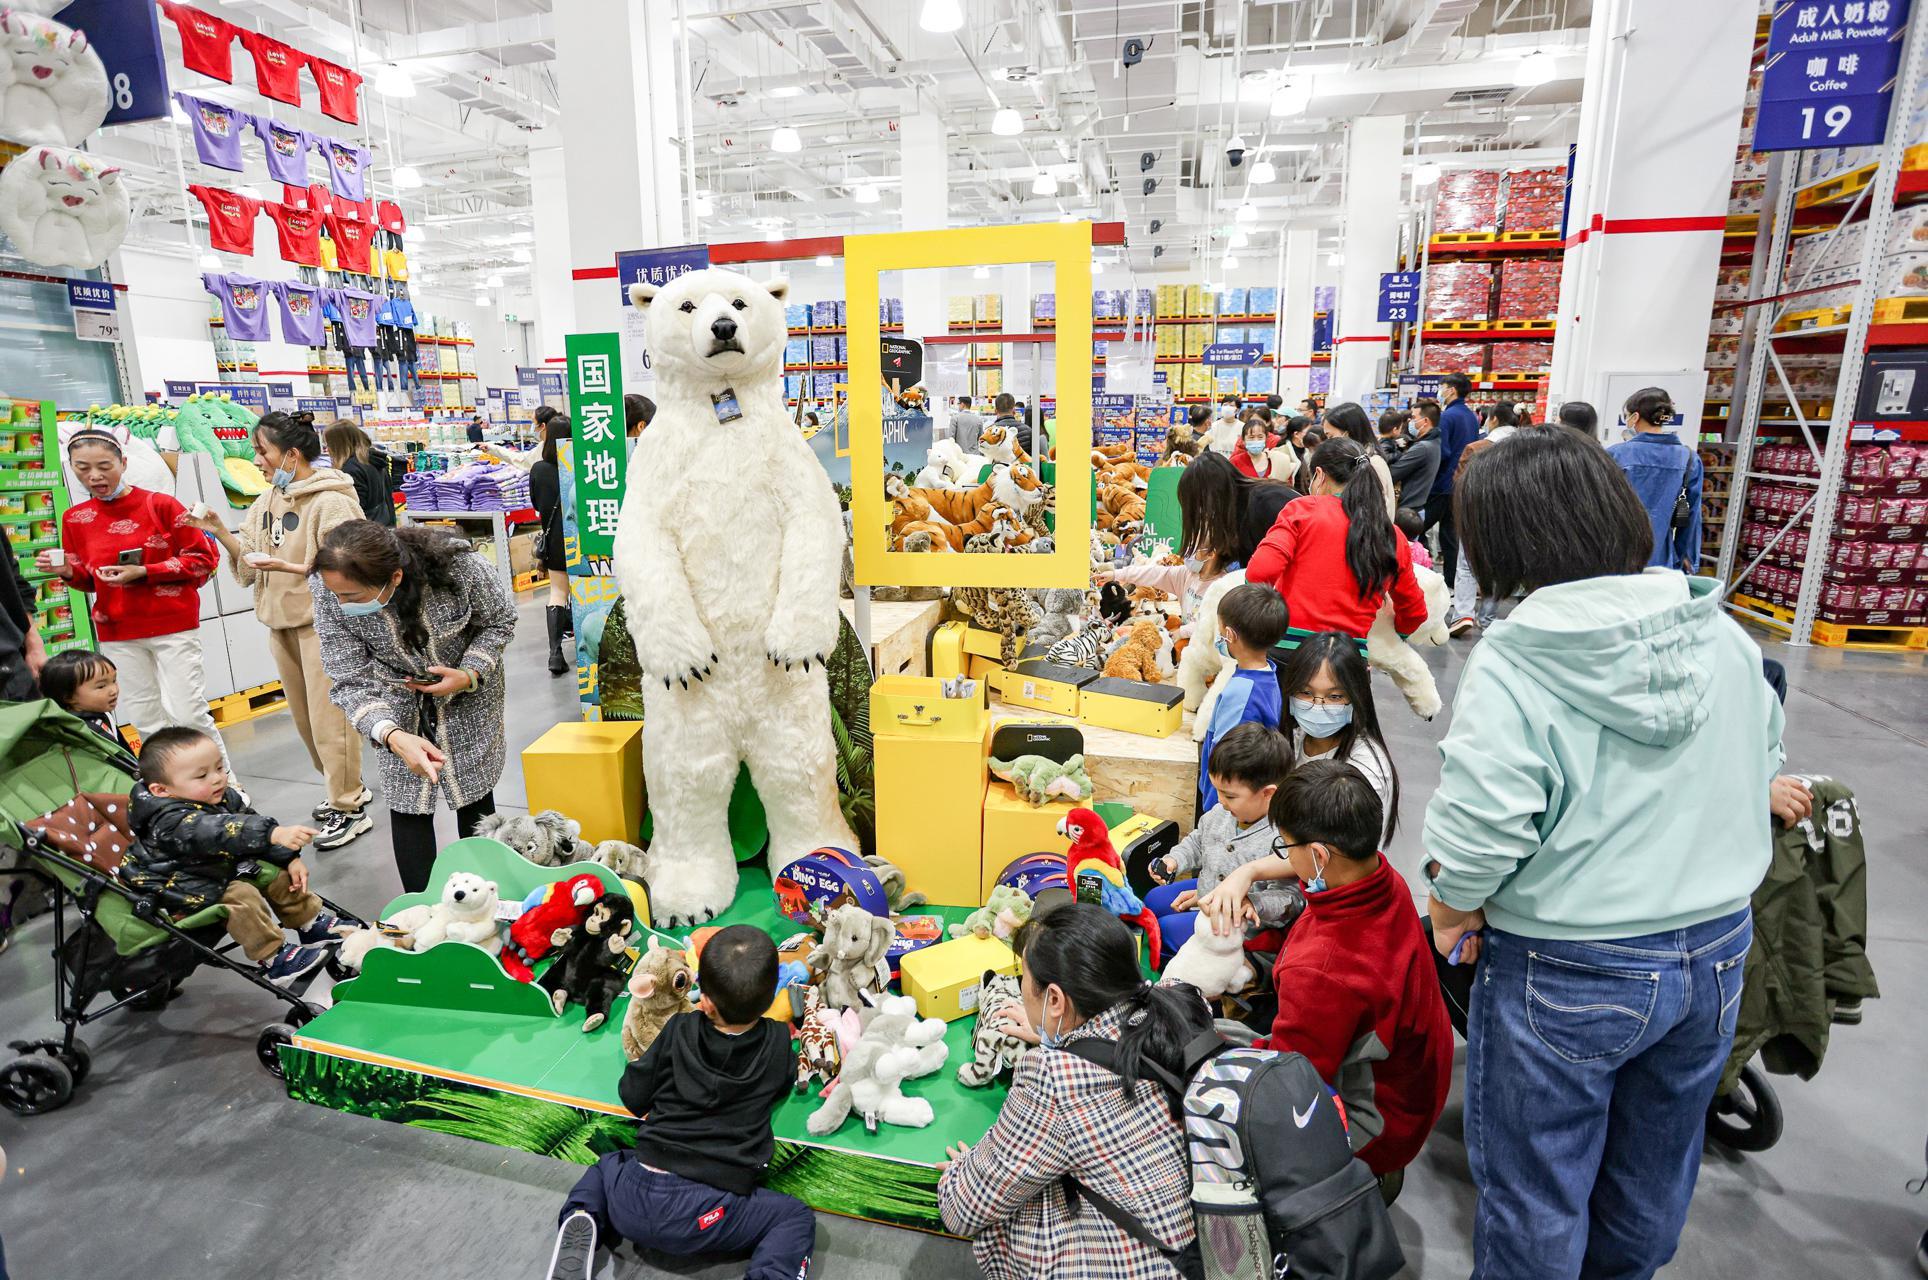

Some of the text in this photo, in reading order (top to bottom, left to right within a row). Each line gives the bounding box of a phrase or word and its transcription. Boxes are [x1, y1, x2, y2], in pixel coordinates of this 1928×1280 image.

[1797, 0, 1890, 28] 成人奶粉
[1789, 26, 1888, 44] Adult Milk Powder
[1806, 53, 1859, 77] 咖啡
[1809, 79, 1848, 91] Coffee
[1801, 104, 1852, 139] 19
[1389, 308, 1407, 320] 23
[577, 353, 620, 536] 国家地理
[792, 870, 816, 886] DINO
[819, 877, 840, 893] EGG
